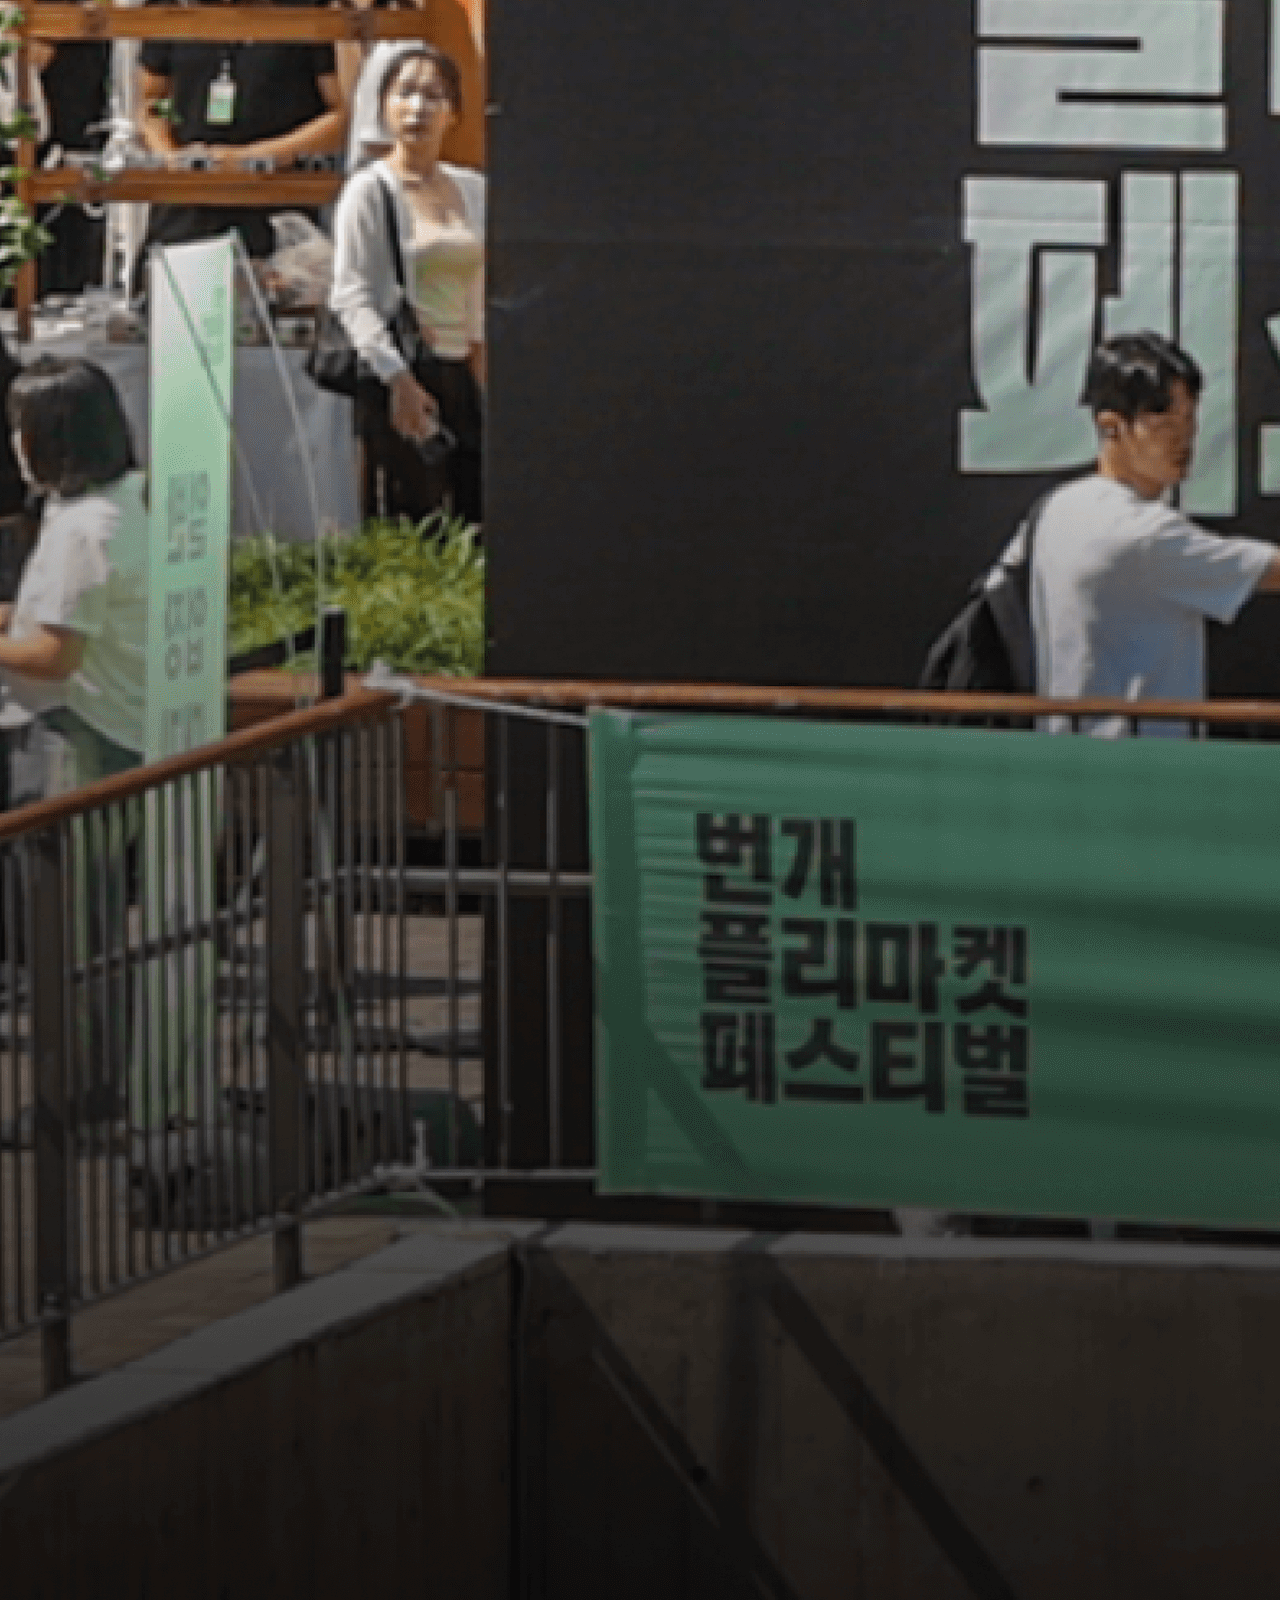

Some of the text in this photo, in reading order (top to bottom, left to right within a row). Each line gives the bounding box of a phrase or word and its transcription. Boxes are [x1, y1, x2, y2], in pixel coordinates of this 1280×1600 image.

[958, 170, 1280, 516] 페
[695, 811, 858, 911] 번개
[696, 910, 1030, 1017] 플리마켓
[701, 1011, 1031, 1119] 페스티벌
